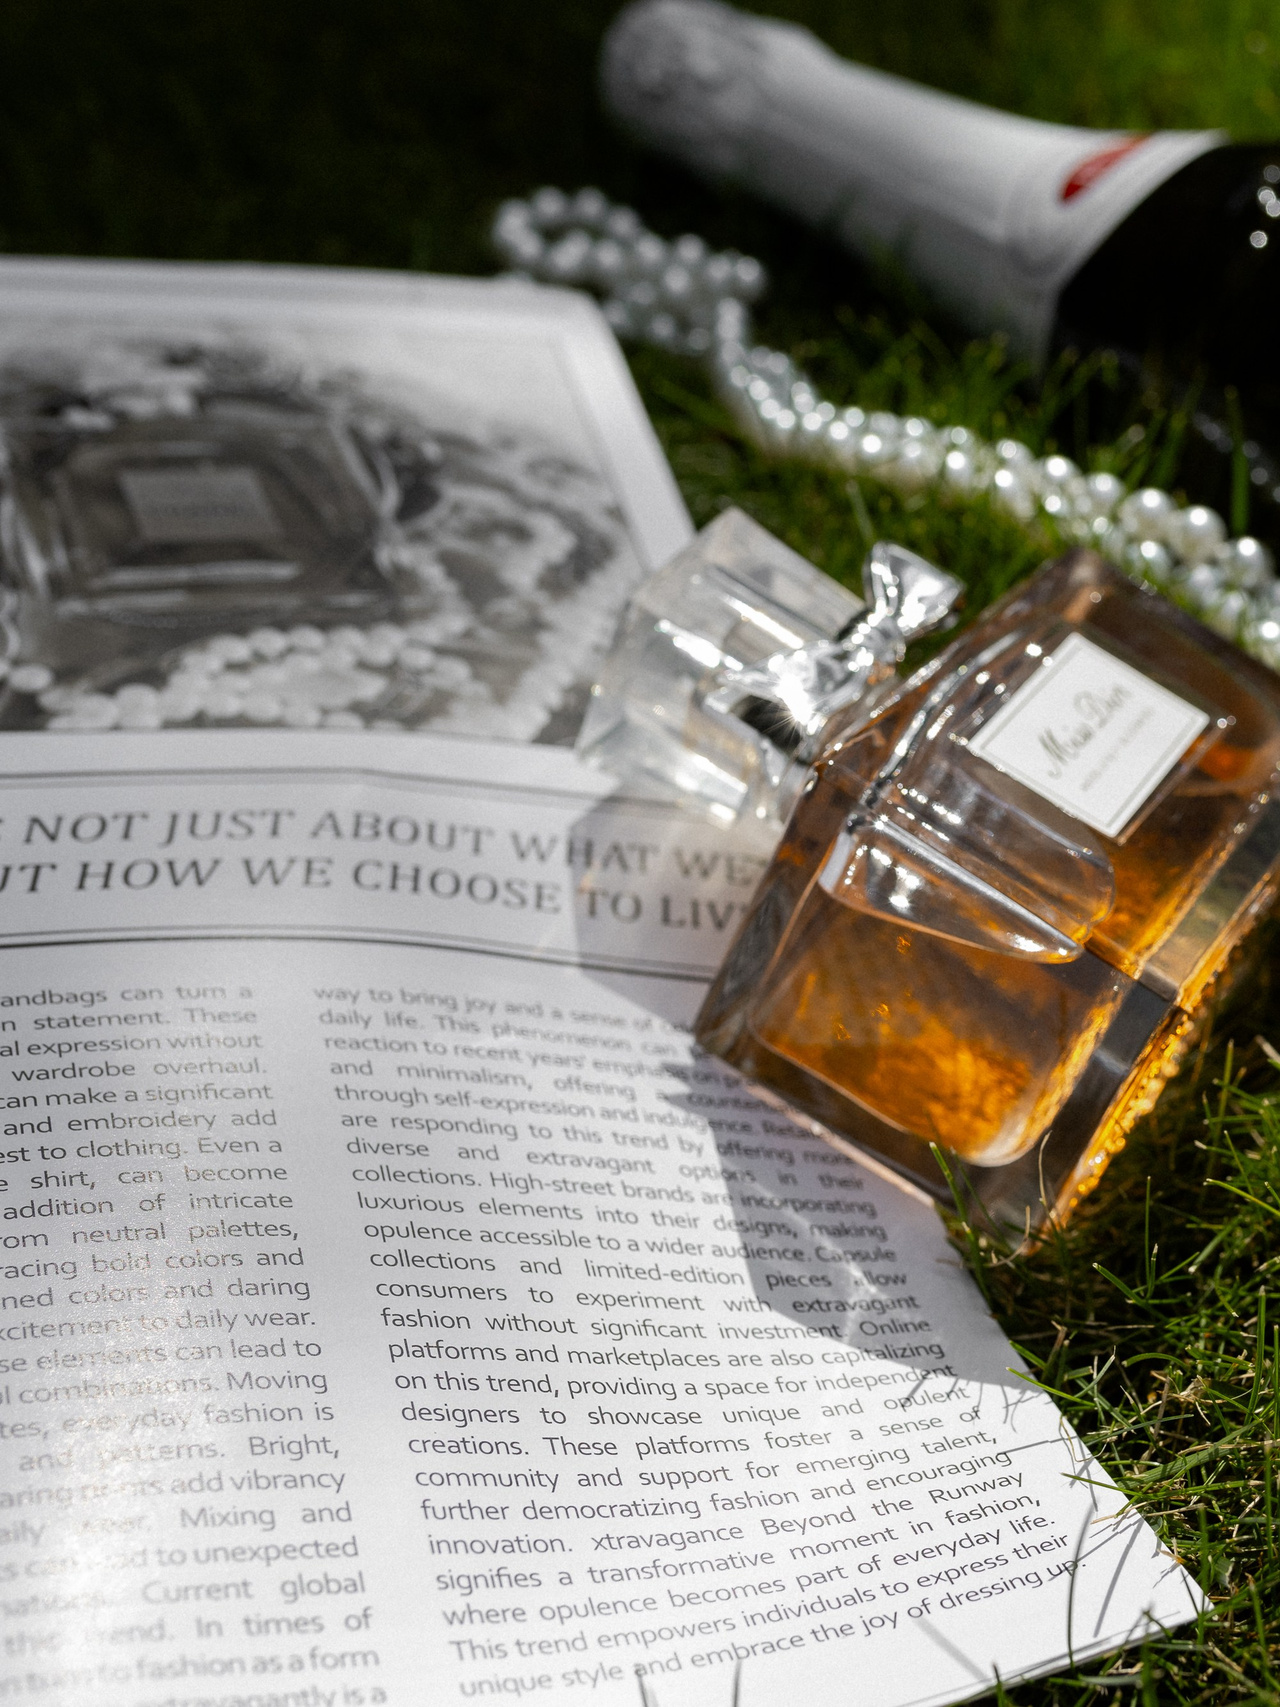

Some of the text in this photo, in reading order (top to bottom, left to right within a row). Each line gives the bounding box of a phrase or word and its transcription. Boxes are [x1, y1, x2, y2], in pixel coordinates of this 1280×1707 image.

[22, 809, 770, 887] NOT JUST ABOUT WHAT WE
[75, 856, 224, 891] HOW
[240, 856, 332, 889] WE
[352, 862, 561, 915] CHOOSE
[575, 888, 642, 922] TO
[660, 894, 751, 931] LIV
[27, 1037, 161, 1058] expression
[324, 1035, 447, 1056] reaction to
[12, 1061, 136, 1082] wardrobe
[331, 1060, 373, 1076] and
[46, 1082, 272, 1105] make a significant
[335, 1086, 429, 1108] through
[4, 1109, 277, 1135] and embroidery add
[341, 1112, 603, 1145] are responding to this
[38, 1146, 66, 1160] to
[198, 1137, 259, 1154] Even
[269, 1139, 282, 1152] a
[347, 1138, 655, 1176] diverse and extravagant
[31, 1164, 287, 1189] shirt, can become
[352, 1165, 695, 1204] collections. brands
[4, 1191, 292, 1219] addition of intricate
[357, 1191, 700, 1229] luxurious elements into their
[72, 1222, 165, 1244] neutral
[189, 1219, 298, 1242] palettes,
[364, 1221, 704, 1256] opulence accessible to a wider
[165, 1248, 304, 1268] colors and
[369, 1249, 744, 1285] collections and limited-edition
[164, 1278, 311, 1299] and daring
[376, 1282, 772, 1312] consumers to experiment with
[245, 1311, 315, 1326] wear.
[381, 1308, 931, 1341] fashion without significant Online
[231, 1338, 321, 1358] lead to
[388, 1338, 944, 1370] platforms and marketplaces are also capitalizing
[227, 1372, 328, 1394] Moving
[395, 1364, 958, 1400] on this trend, providing a space for independent
[203, 1402, 334, 1425] fashion is
[401, 1400, 864, 1427] designers to showcase unique and
[249, 1436, 339, 1460] Bright,
[408, 1406, 981, 1460] creations. These platforms foster a sense of
[415, 1430, 997, 1492] community and support for emerging talent,
[231, 1470, 345, 1492] vibrancy
[421, 1452, 1012, 1521] further democratizing fashion and encouraging
[181, 1501, 352, 1531] Mixing and
[428, 1472, 1024, 1555] innovation. xtravagance Beyond the Runway
[194, 1536, 359, 1566] unexpected
[436, 1494, 1041, 1596] signifies a transformative moment in fashion,
[443, 1514, 1055, 1626] where opulence becomes part of everyday life.
[281, 1571, 366, 1604] global
[448, 1533, 1069, 1662] This trend empowers individuals to express their
[344, 1606, 373, 1631] of
[690, 1569, 1042, 1668] embrace the joy of dressing
